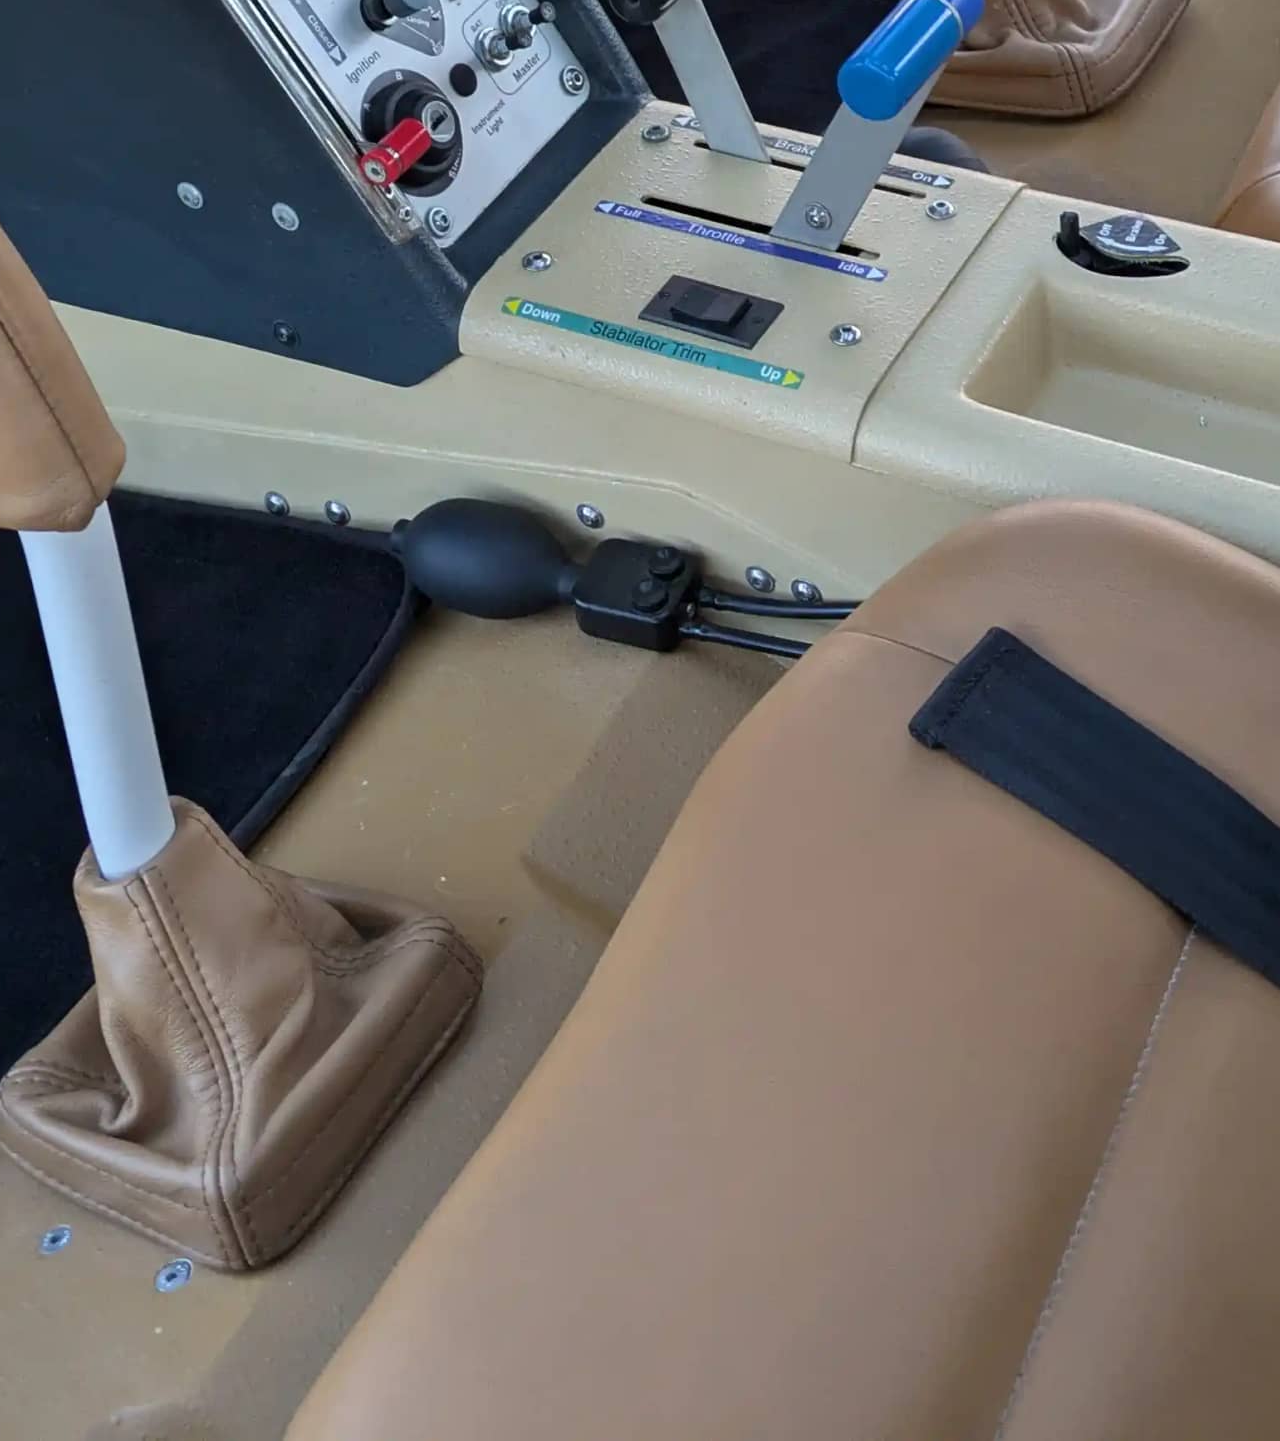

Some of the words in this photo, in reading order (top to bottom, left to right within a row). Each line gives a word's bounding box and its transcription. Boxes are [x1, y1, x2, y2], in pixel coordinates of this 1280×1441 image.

[307, 13, 336, 49] Closed
[345, 48, 382, 84] Ignition
[512, 52, 541, 83] Master
[471, 99, 507, 134] Instrument
[487, 116, 505, 137] Light
[911, 171, 933, 185] On
[615, 204, 642, 219] Full
[687, 222, 746, 247] Throttle
[1099, 223, 1113, 237] Off
[1124, 219, 1145, 243] Brake
[1154, 233, 1168, 245] On
[837, 260, 866, 276] Idle
[520, 302, 562, 325] Down
[589, 320, 670, 353] Stabilator
[670, 341, 707, 365] Trim
[760, 366, 782, 383] Up
